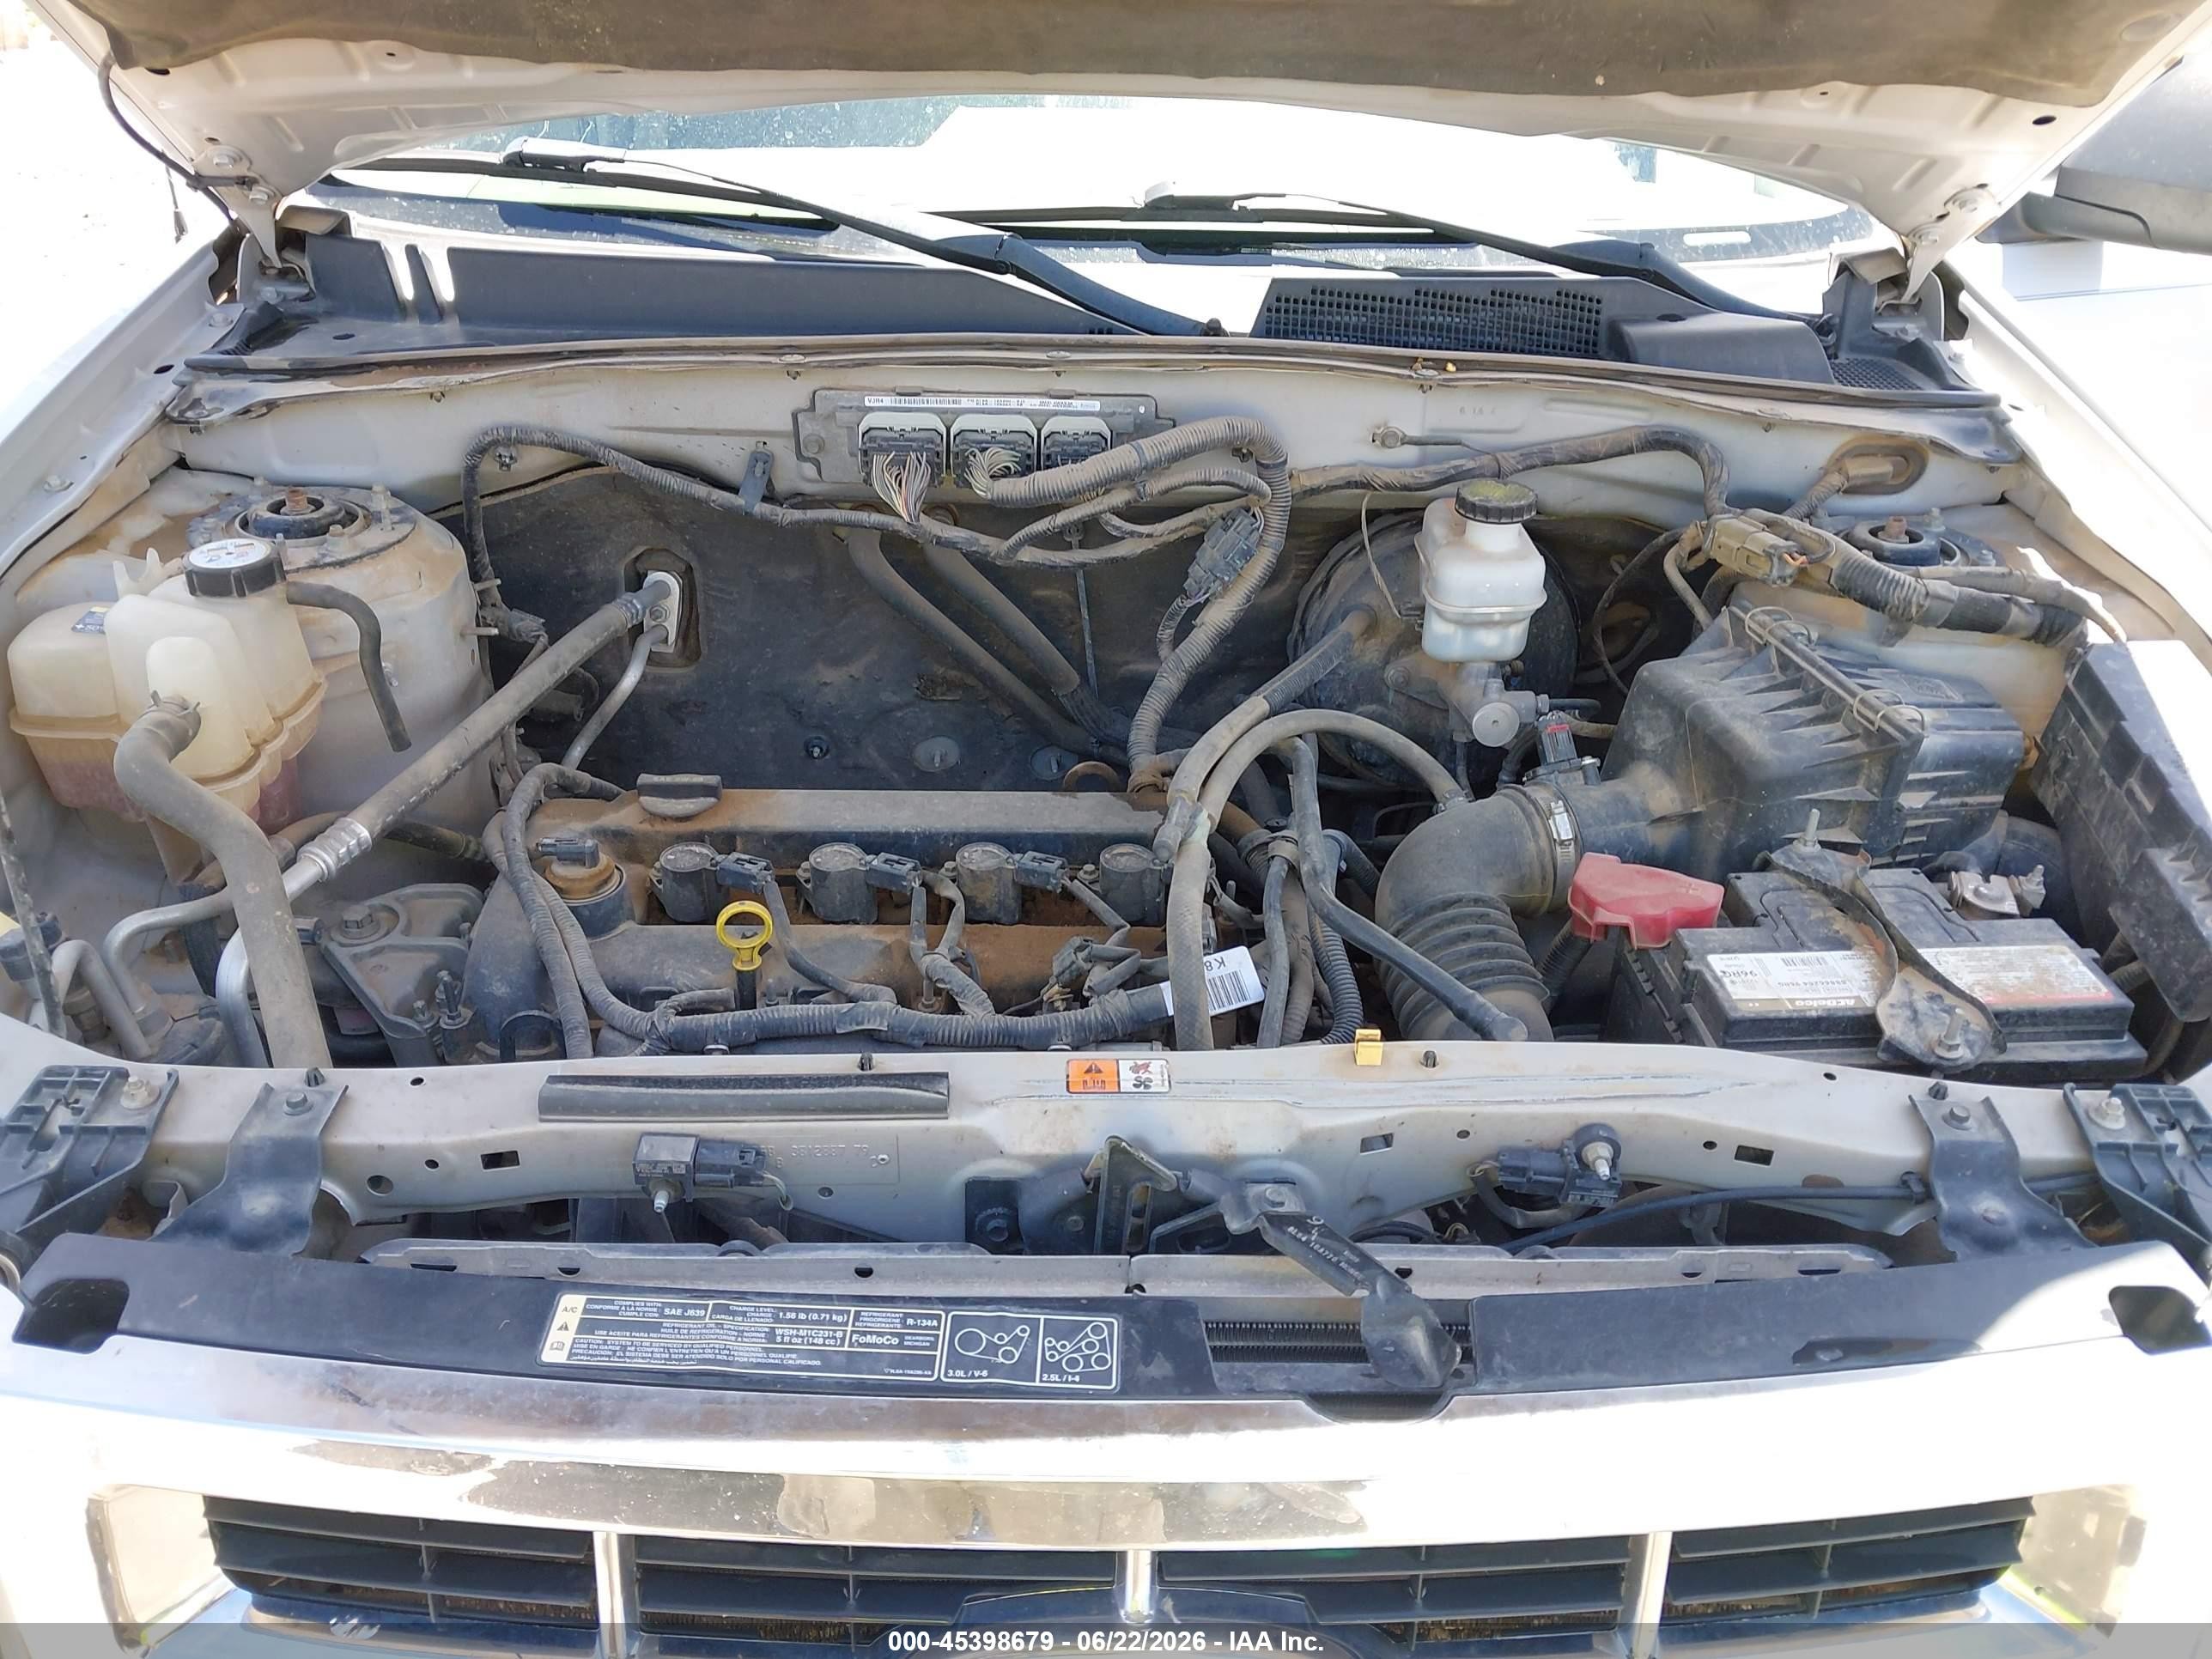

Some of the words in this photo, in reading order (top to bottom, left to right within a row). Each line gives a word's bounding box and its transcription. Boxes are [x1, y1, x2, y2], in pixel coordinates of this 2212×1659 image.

[1795, 998, 1856, 1007] ACDelco
[664, 1308, 683, 1316] SAE
[684, 1309, 706, 1317] J639
[779, 1311, 797, 1320] 1.56
[808, 1312, 830, 1321] (0.71
[832, 1313, 848, 1322] kg)
[906, 1318, 939, 1328] R-134A
[804, 1336, 823, 1345] (148
[824, 1338, 841, 1346] cc)
[852, 1334, 900, 1345] FoMoCo
[947, 1369, 966, 1377] 3.0L
[1042, 1373, 1061, 1382] 2.5L
